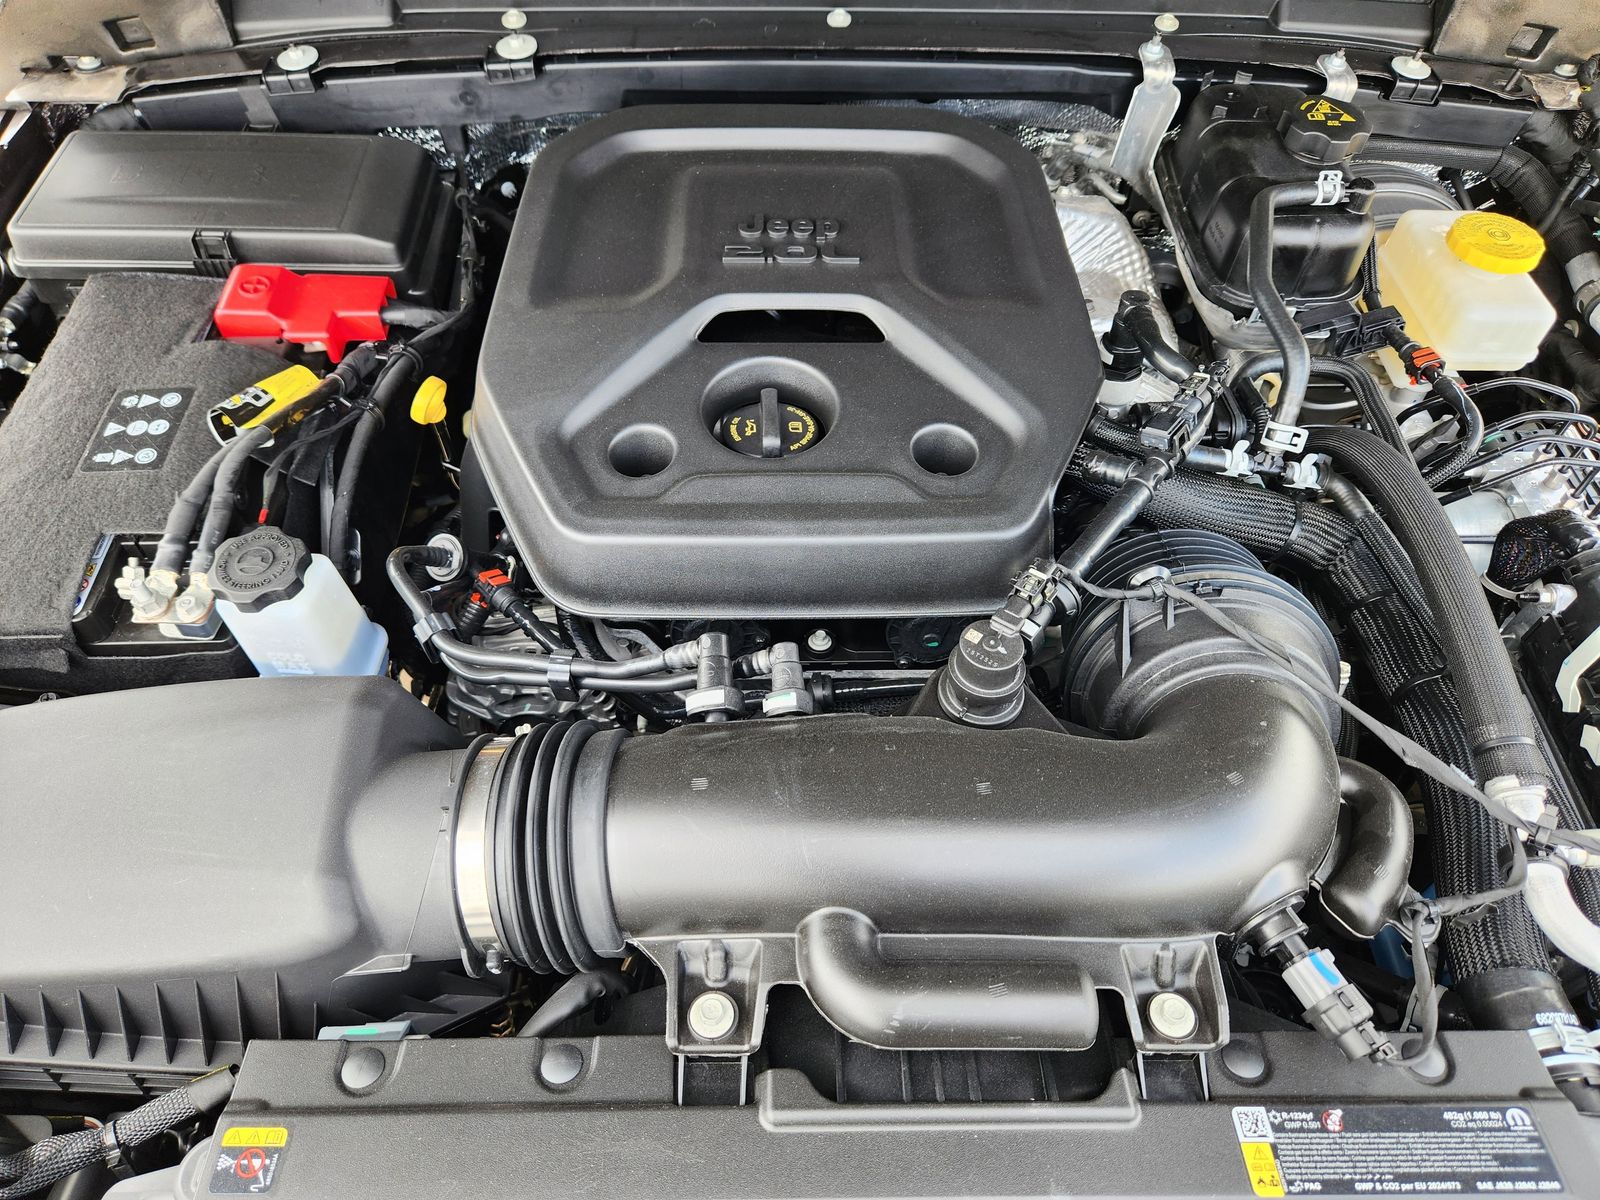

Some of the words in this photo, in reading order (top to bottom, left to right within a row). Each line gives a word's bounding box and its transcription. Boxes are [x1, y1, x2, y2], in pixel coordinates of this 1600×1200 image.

[738, 213, 840, 243] Jeep
[722, 243, 860, 264] 2.0L
[230, 537, 249, 550] USE
[249, 532, 291, 550] APPROVED
[1284, 1121, 1302, 1129] GWP
[1451, 1120, 1467, 1128] CO2
[1304, 1182, 1322, 1191] PAG
[1354, 1182, 1374, 1190] GWP
[1383, 1182, 1400, 1190] CO2
[1414, 1182, 1426, 1190] EU
